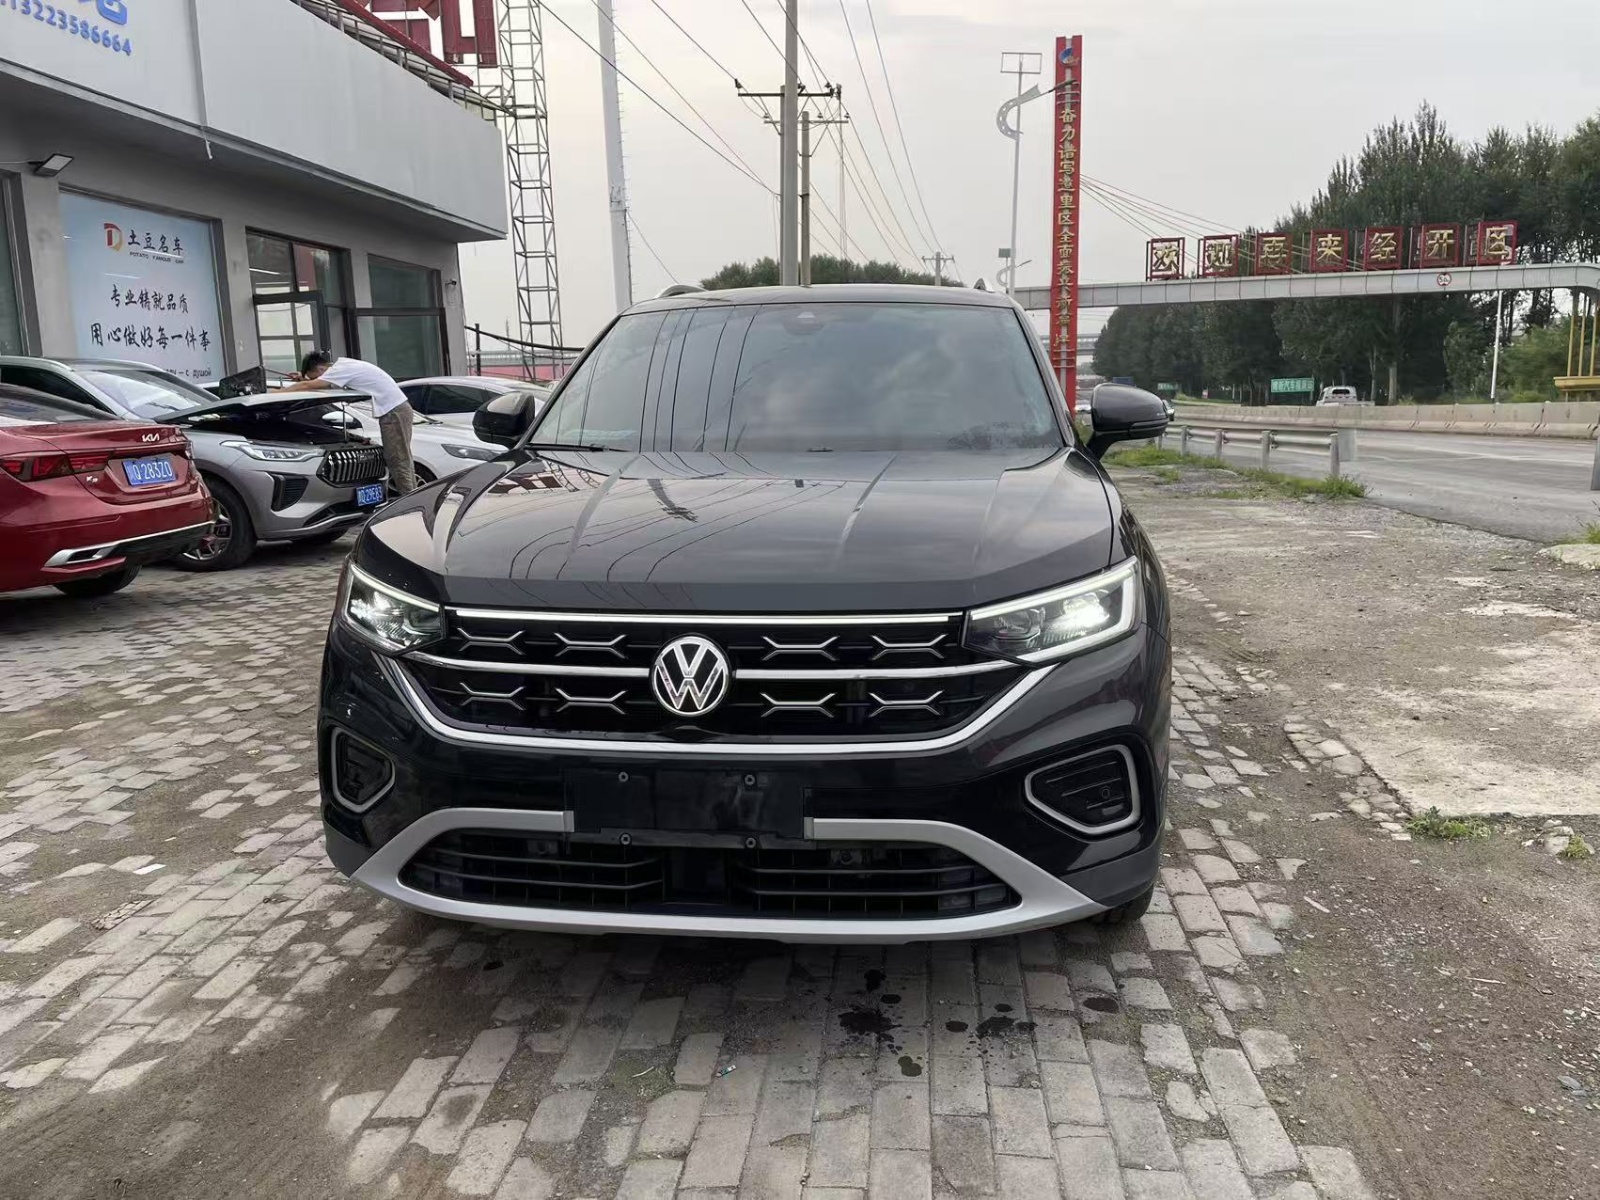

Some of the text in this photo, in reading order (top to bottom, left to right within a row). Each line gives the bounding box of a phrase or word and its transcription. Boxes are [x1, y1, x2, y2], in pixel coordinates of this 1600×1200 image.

[127, 229, 184, 256] 土豆名车
[110, 284, 189, 314] 专业铸就品质
[90, 322, 211, 352] 用心做好每一件事
